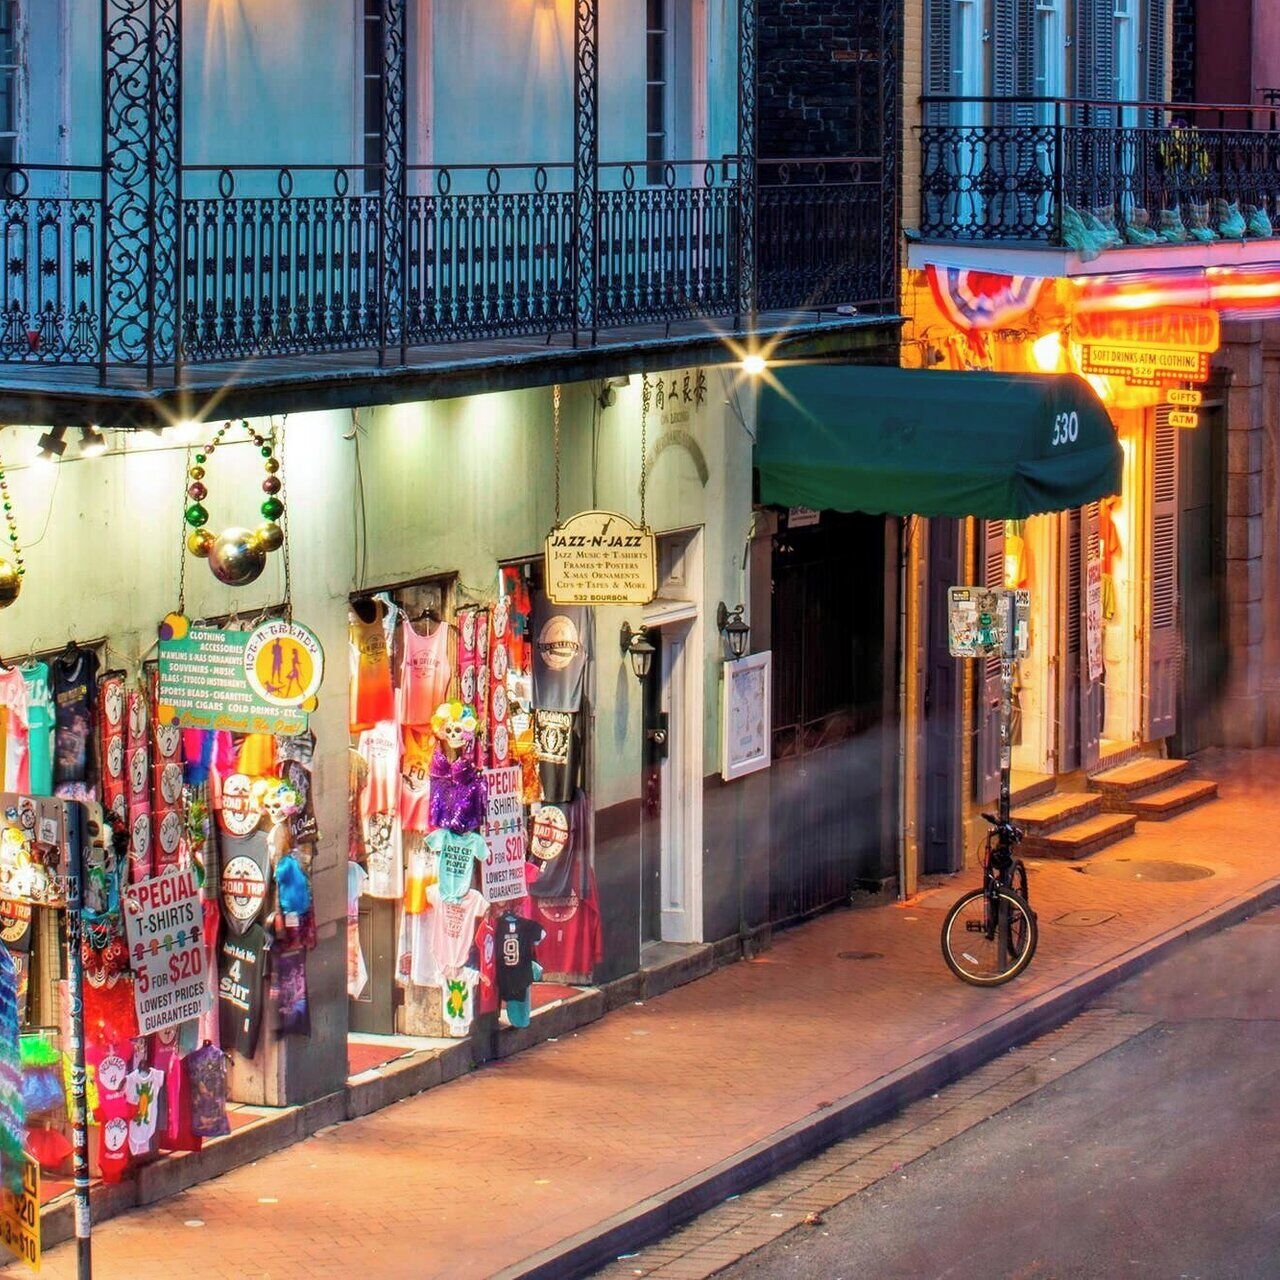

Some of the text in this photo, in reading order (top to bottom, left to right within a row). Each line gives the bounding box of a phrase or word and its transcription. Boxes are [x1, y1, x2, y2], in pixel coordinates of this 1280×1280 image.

[1159, 354, 1196, 368] CLOTHING
[1135, 367, 1152, 376] 526
[1170, 393, 1197, 403] GIFTS
[1172, 414, 1194, 425] ATM
[1052, 411, 1079, 446] 530
[551, 536, 642, 547] JAZZ-N-JAZZ
[189, 631, 226, 641] CLOTHING
[200, 643, 244, 653] ACCESSORIES
[208, 655, 244, 665] ORNAMENTS
[169, 663, 236, 676] SOUVENIRS MUSIC
[161, 674, 180, 683] FLAGS
[160, 686, 253, 702] SPORTS BEADS CIGARETTES
[160, 697, 193, 708] PREMIUM
[195, 700, 223, 711] CIGARS
[228, 704, 249, 714] COLD
[250, 705, 279, 716] DRINKS
[495, 852, 505, 864] FOR
[505, 837, 522, 864] $20
[486, 870, 508, 884] LOWEST
[127, 872, 198, 916] SPECIAL
[136, 903, 194, 936] T-SHIRTS
[504, 939, 520, 965] 9
[137, 948, 202, 993] 5 FOR $20
[229, 960, 241, 982] 4
[140, 982, 205, 1015] LOWEST PRICES
[145, 1001, 202, 1031] GUARANTEED!
